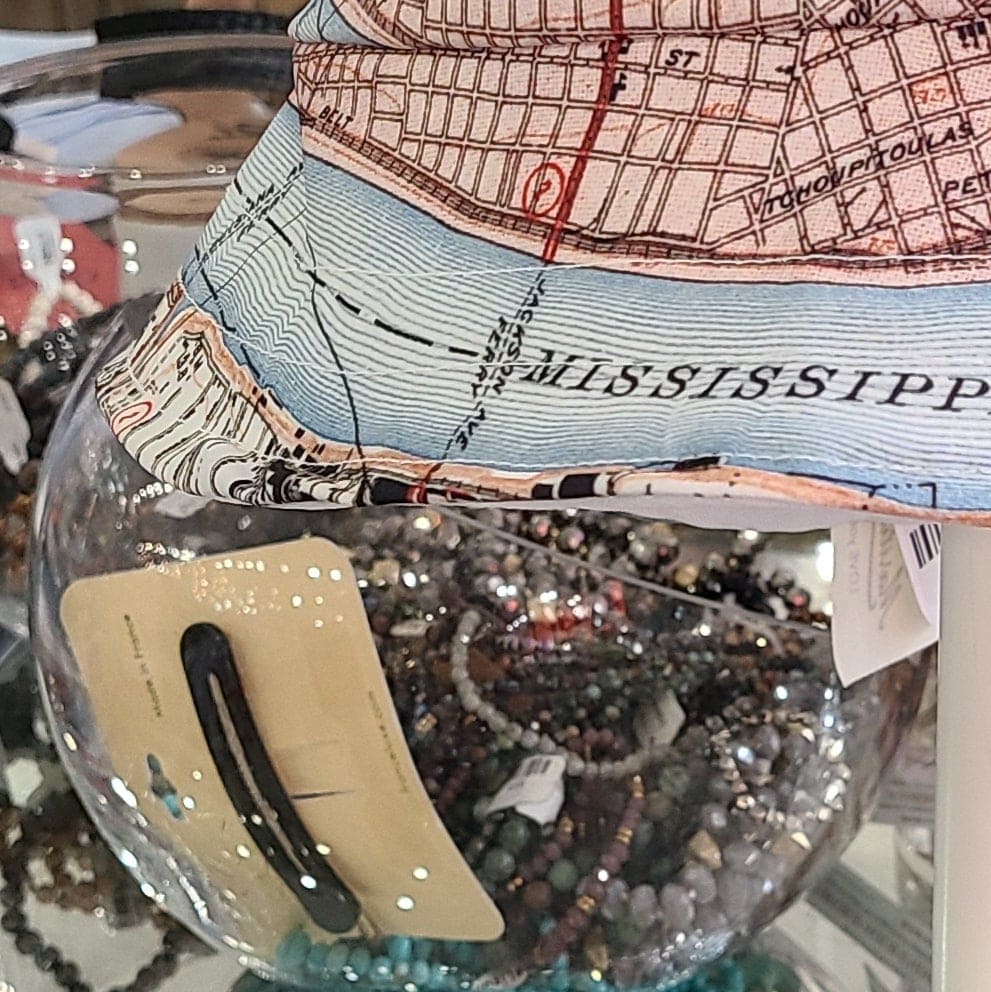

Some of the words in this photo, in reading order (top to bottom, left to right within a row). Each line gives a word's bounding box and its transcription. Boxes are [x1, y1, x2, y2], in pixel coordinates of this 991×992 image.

[664, 48, 701, 68] ST
[318, 105, 354, 130] BELT
[764, 122, 974, 214] TCHOUPITOULAS
[470, 315, 507, 399] FERRY
[491, 278, 546, 396] JACKSON
[455, 406, 486, 451] AVE
